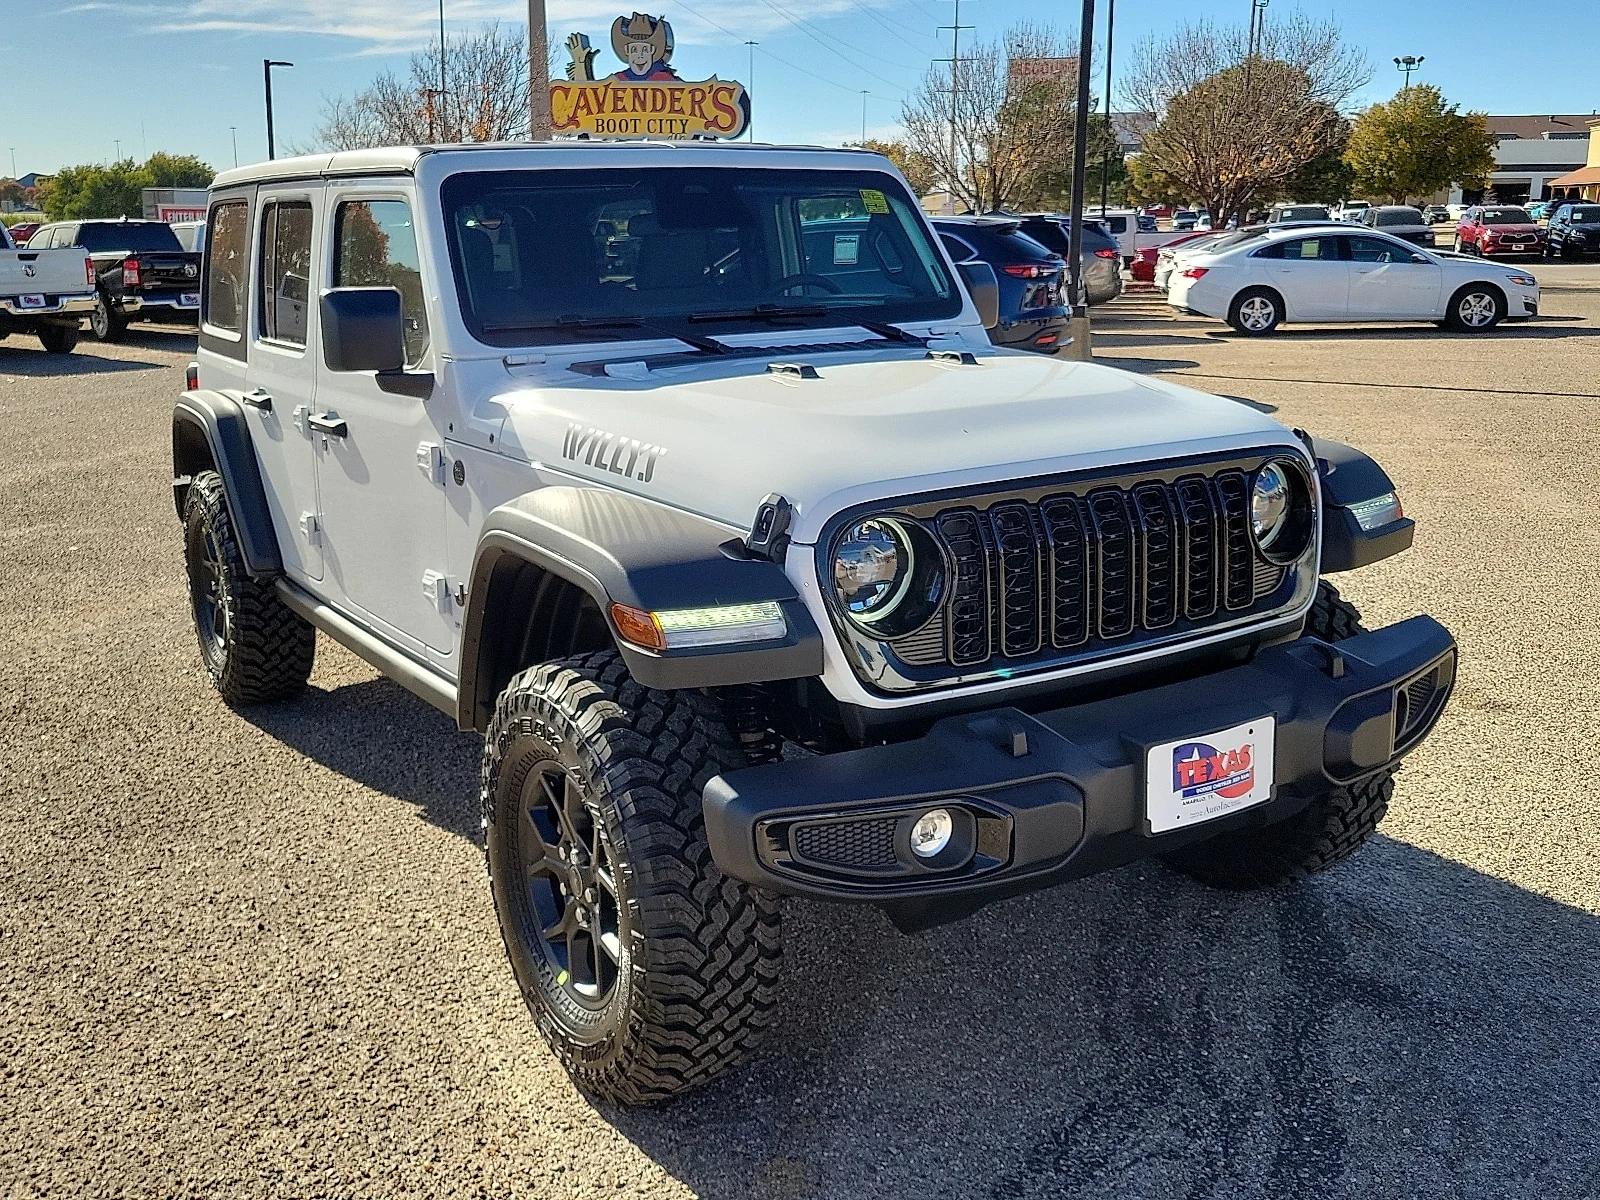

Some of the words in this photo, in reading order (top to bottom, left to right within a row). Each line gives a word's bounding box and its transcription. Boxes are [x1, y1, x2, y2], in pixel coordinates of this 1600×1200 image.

[550, 82, 737, 131] CAVENDER'S
[595, 118, 641, 133] BOOT
[647, 118, 689, 134] CITY
[563, 422, 669, 483] WILLYS
[1176, 743, 1252, 787] TEXAS
